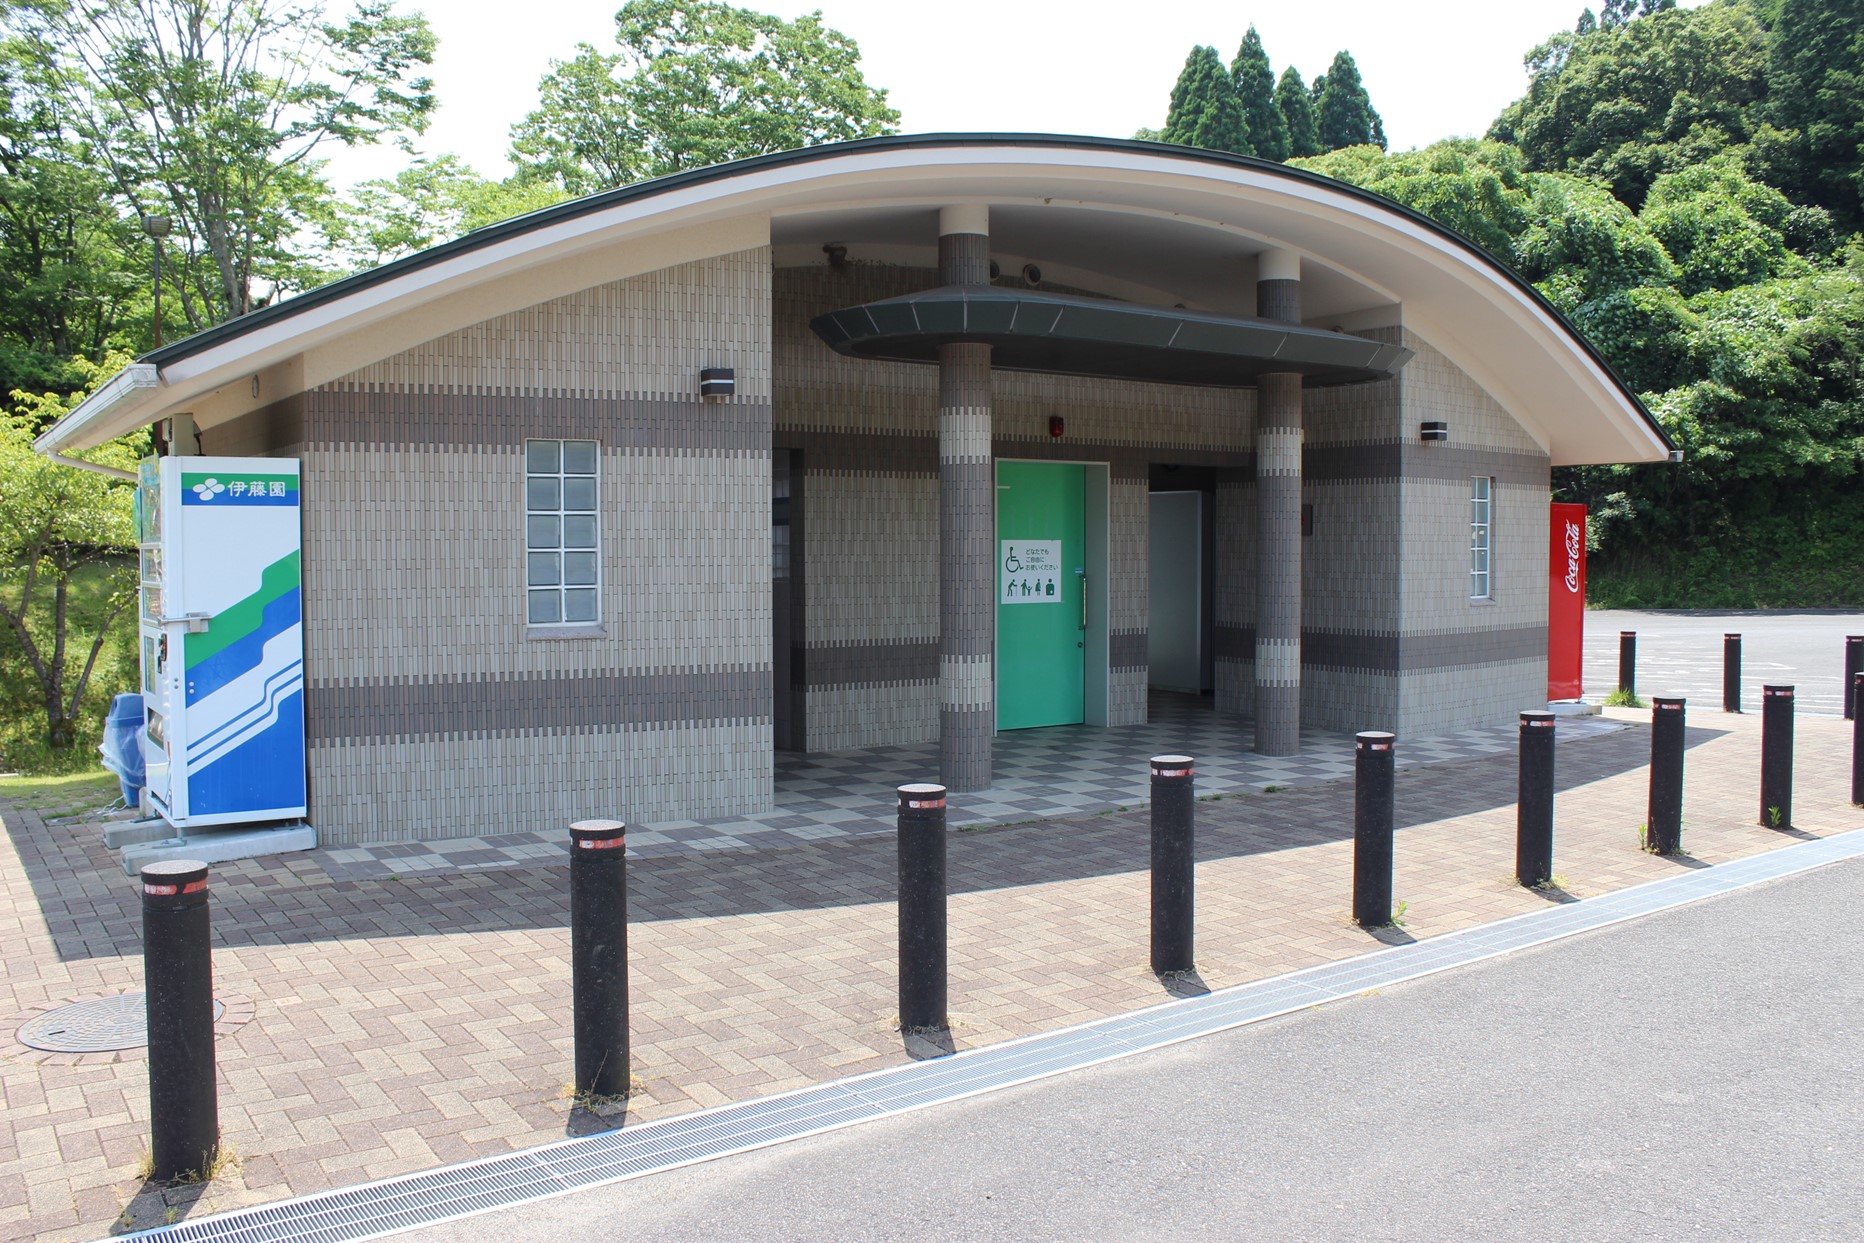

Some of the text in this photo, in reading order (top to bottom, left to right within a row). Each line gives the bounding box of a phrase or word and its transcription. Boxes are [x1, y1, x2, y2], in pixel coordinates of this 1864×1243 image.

[228, 481, 285, 497] 伊藤園
[1565, 519, 1580, 593] Coca-Cola
